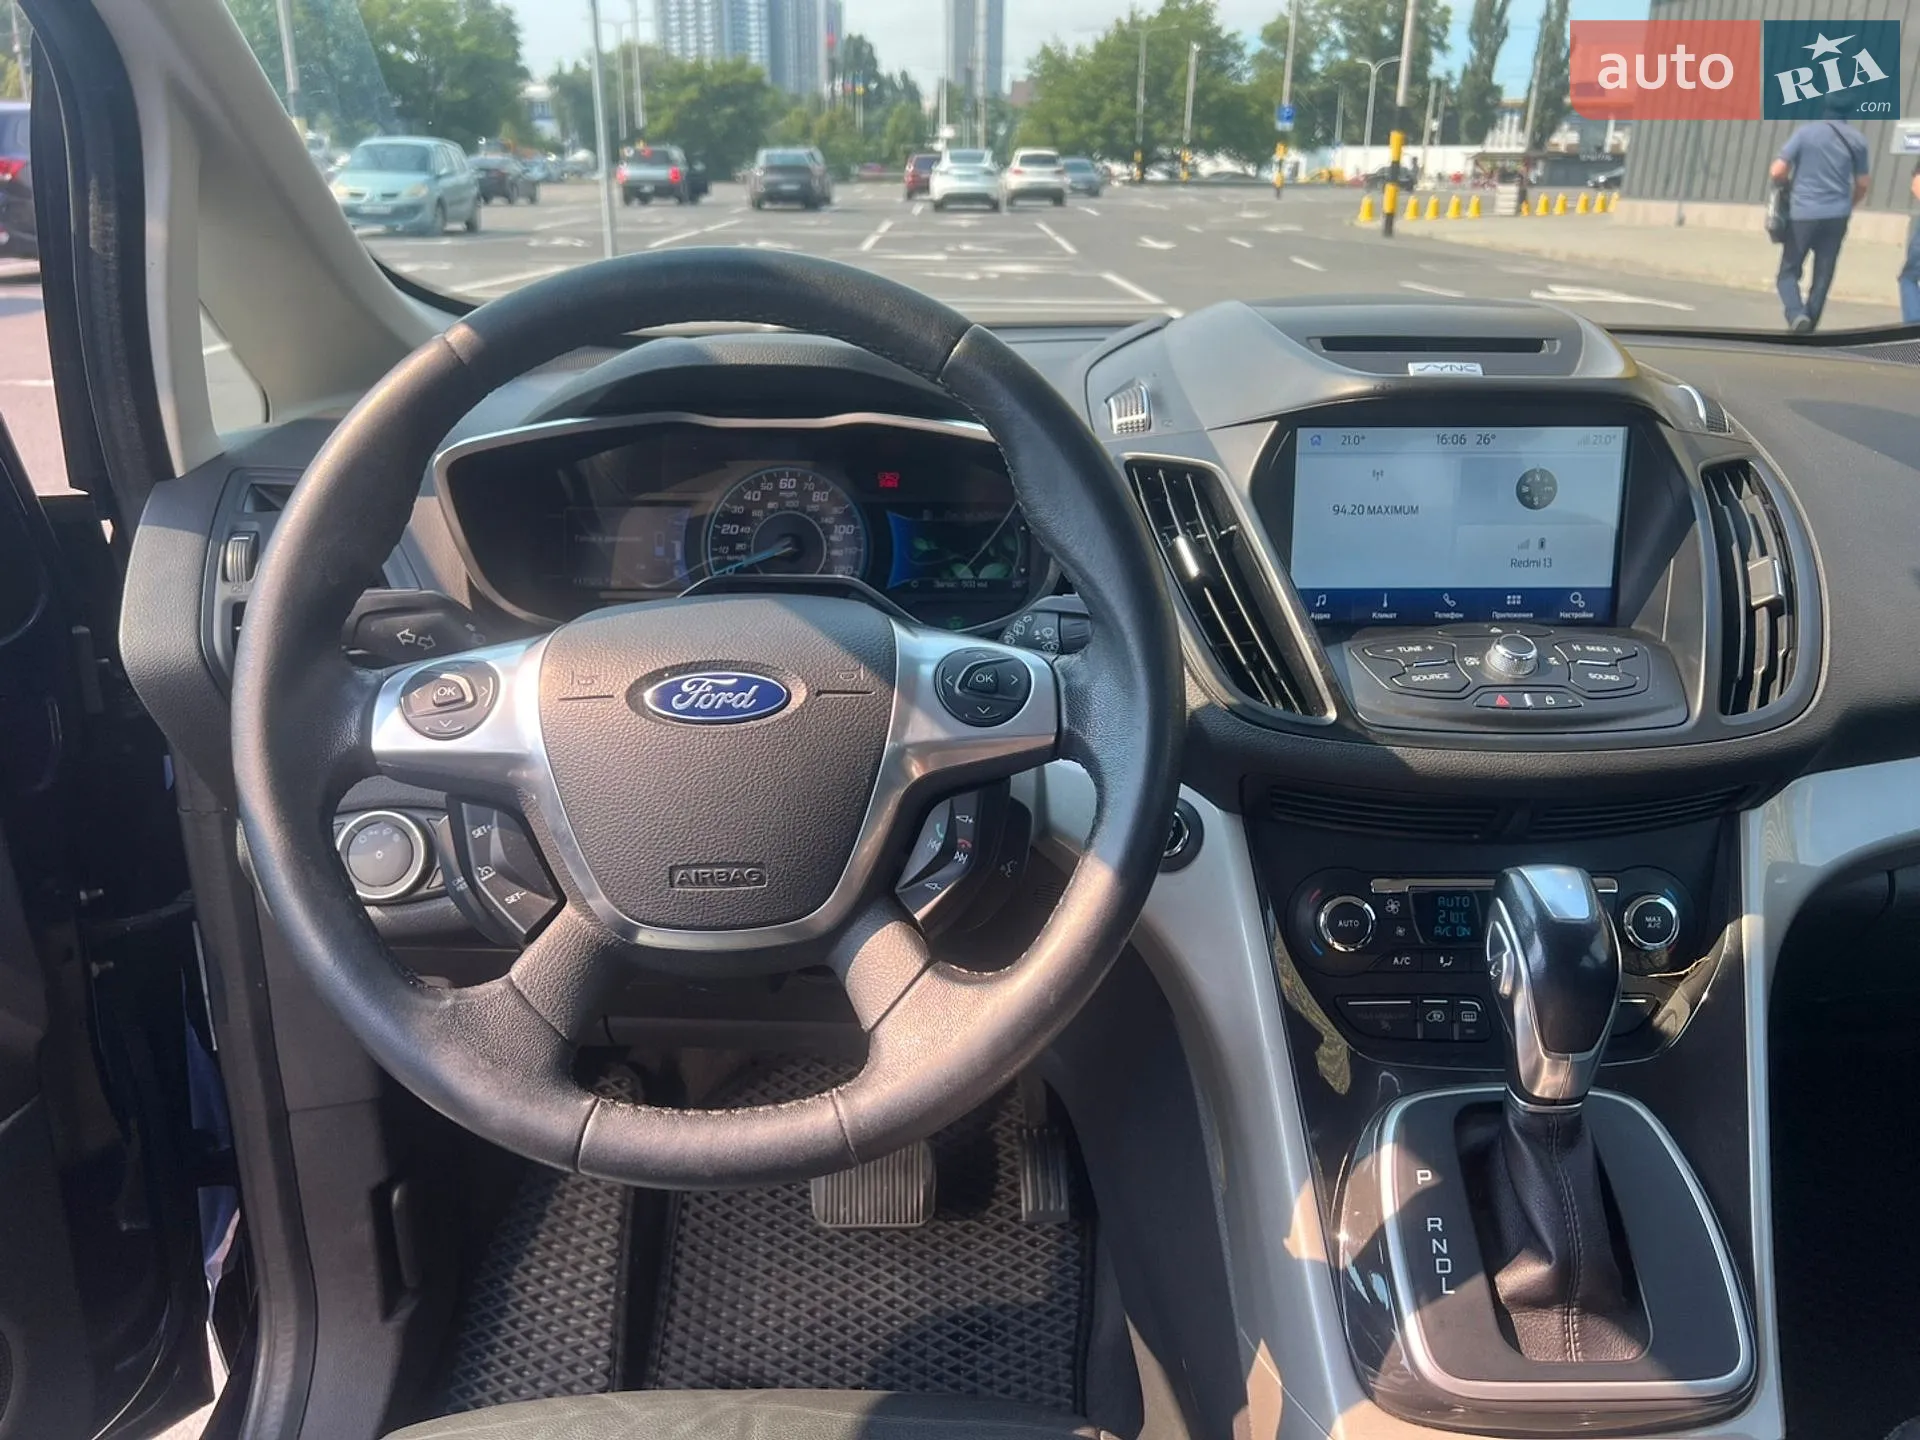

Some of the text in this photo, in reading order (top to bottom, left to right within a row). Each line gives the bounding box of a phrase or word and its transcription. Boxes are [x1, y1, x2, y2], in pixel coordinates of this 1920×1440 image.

[1436, 433, 1467, 446] 16:06
[1476, 433, 1497, 446] 26°
[760, 482, 773, 491] 50
[779, 478, 797, 489] 60
[803, 482, 815, 491] 70
[743, 490, 762, 501] 40
[812, 491, 830, 502] 80
[731, 506, 744, 514] 30
[1332, 503, 1420, 516] 94.20 MAXIMUM
[721, 524, 739, 535] 20
[834, 524, 855, 535] 100
[1510, 558, 1553, 569] Redmi 13
[1434, 611, 1464, 619] Телефон
[1492, 611, 1534, 619] Приложения
[975, 674, 994, 684] OK
[1411, 673, 1451, 682] SOURCE
[1588, 672, 1620, 682] SOUND
[437, 686, 456, 696] OK
[671, 677, 760, 711] Ford
[674, 867, 762, 886] AIRBAG
[1438, 896, 1470, 907] AUTO
[1338, 919, 1360, 927] AUTO
[1393, 956, 1411, 965] A/C
[1416, 1169, 1432, 1185] P
[1426, 1217, 1443, 1232] R
[1431, 1238, 1448, 1254] N
[1435, 1258, 1452, 1274] D
[1442, 1276, 1456, 1294] L
